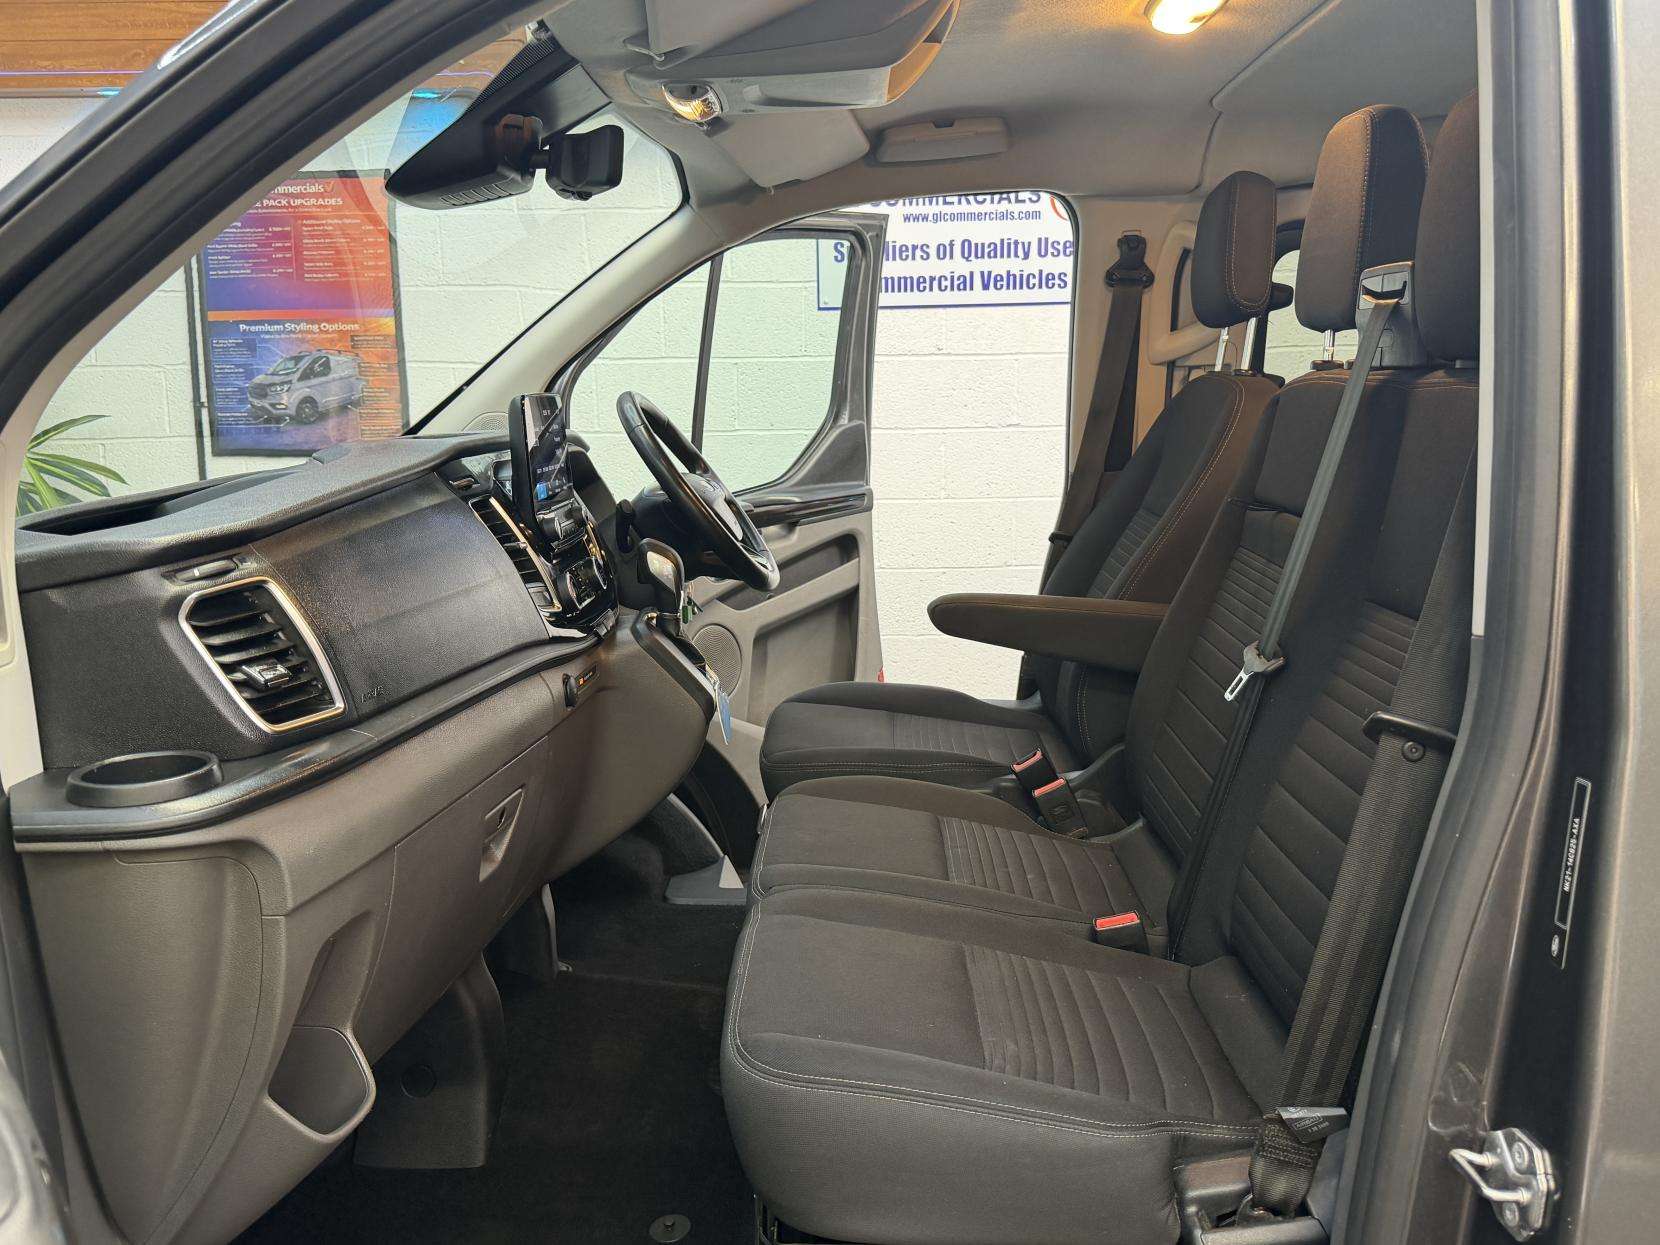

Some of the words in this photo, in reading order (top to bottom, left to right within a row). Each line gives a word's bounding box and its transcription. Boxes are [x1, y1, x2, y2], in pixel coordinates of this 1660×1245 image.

[271, 183, 324, 194] mmercials
[262, 199, 288, 207] PACK
[290, 198, 343, 206] UPGRADES
[902, 208, 1041, 224] www.glcommercials.com
[936, 239, 955, 260] of
[960, 237, 1032, 262] Quality
[879, 270, 975, 294] mmercial
[979, 269, 1068, 292] Vehicles
[240, 323, 284, 332] Premium
[284, 322, 319, 333] Styling
[320, 322, 361, 332] Options
